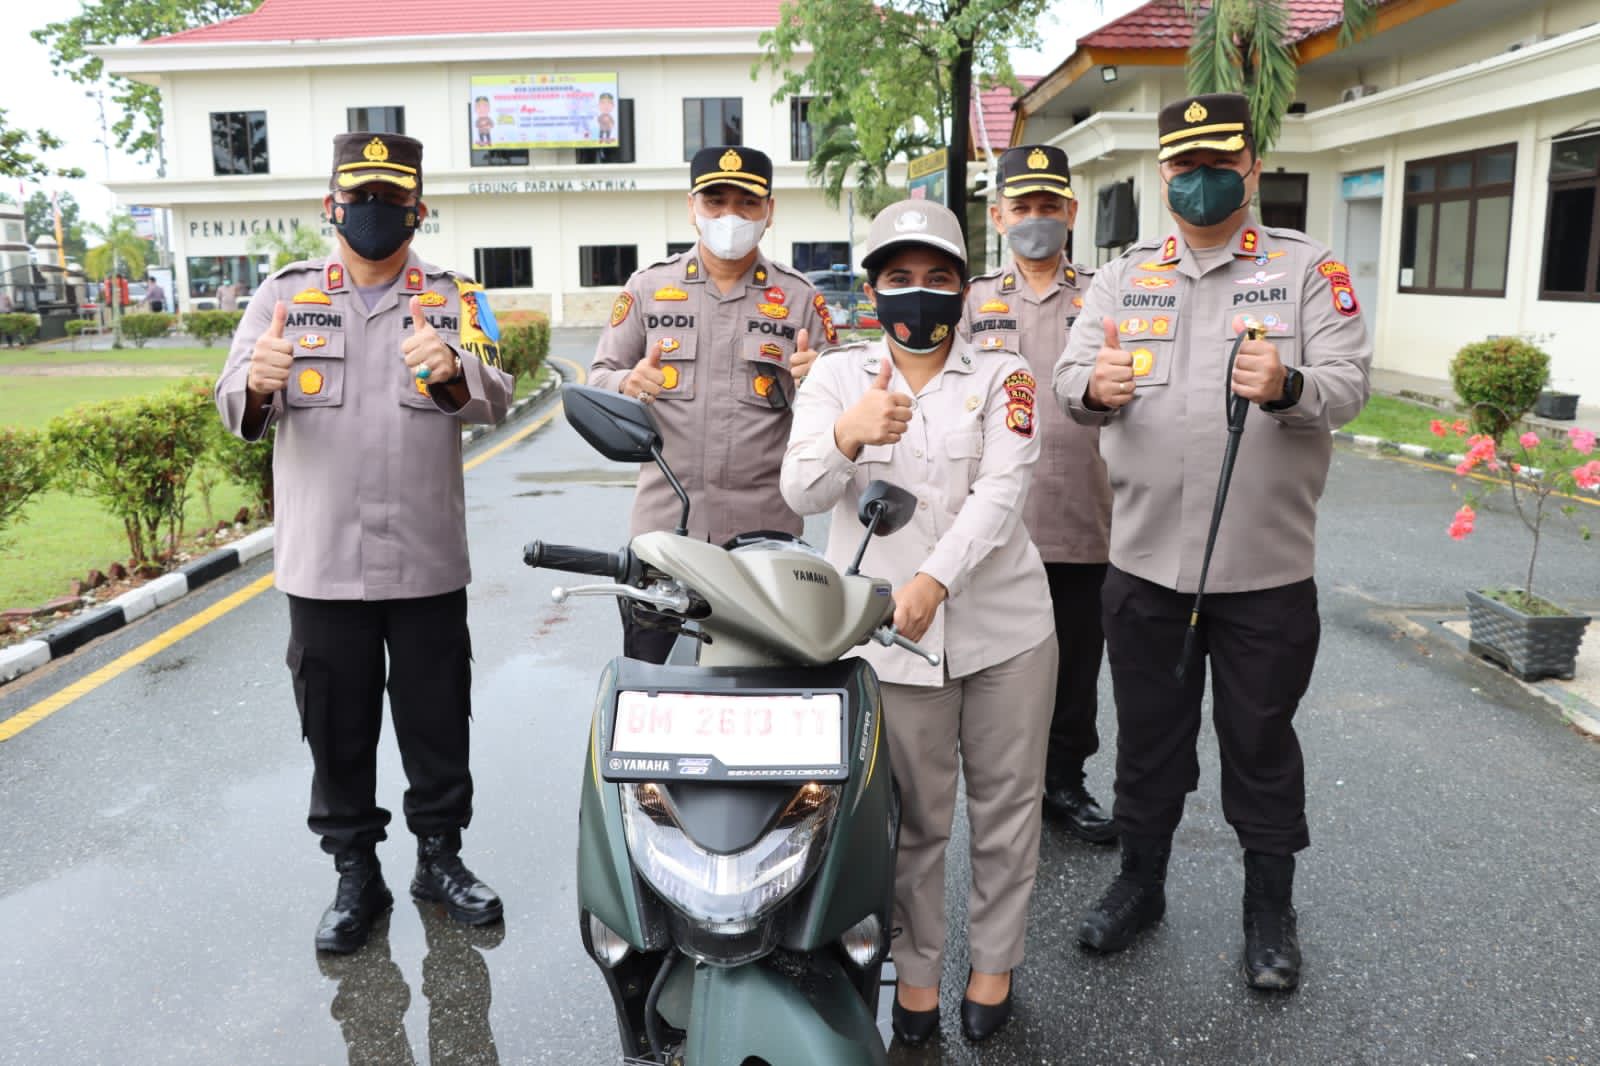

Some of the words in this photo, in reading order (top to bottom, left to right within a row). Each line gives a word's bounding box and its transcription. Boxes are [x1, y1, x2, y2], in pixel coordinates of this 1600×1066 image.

[469, 181, 518, 193] GEDUNG
[525, 180, 573, 193] PARAMA
[582, 179, 637, 192] SATWIKA
[189, 217, 299, 238] PENJAGAAN
[1122, 293, 1176, 307] GUNTUR
[1233, 287, 1287, 305] POLRI
[285, 312, 342, 328] ANTONI
[403, 315, 457, 330] PLRI
[647, 315, 695, 329] DODI
[748, 319, 796, 341] POLRI
[1010, 389, 1032, 403] RIAU
[793, 569, 829, 586] YAMAHA
[627, 703, 673, 735] BM
[859, 711, 872, 761] GEAR
[623, 759, 671, 772] YAMAHA
[727, 769, 783, 777] SEMAKIN
[797, 768, 840, 777] DEPAN
